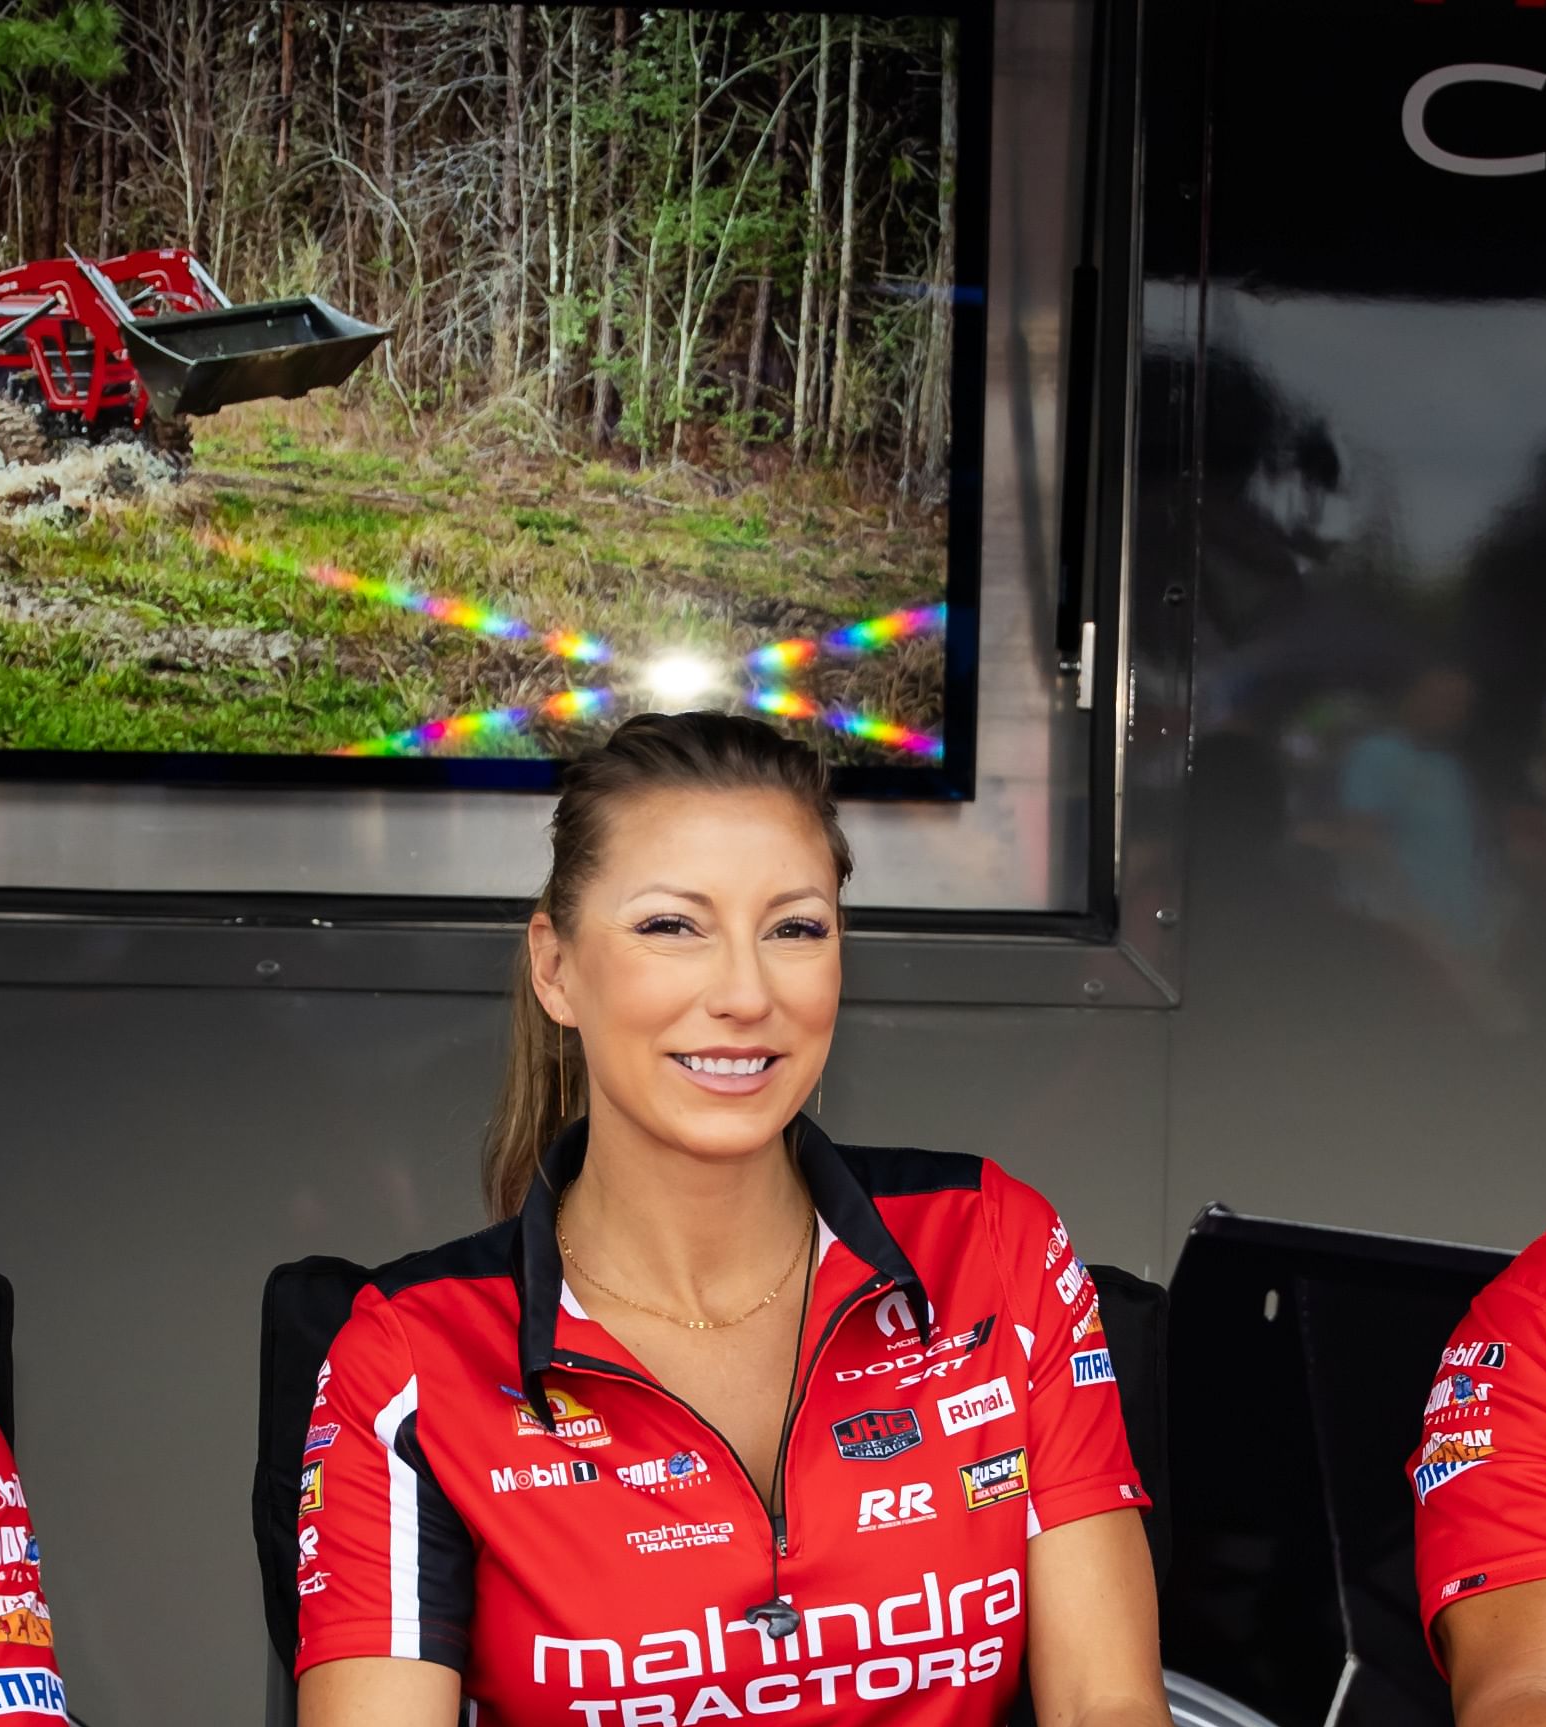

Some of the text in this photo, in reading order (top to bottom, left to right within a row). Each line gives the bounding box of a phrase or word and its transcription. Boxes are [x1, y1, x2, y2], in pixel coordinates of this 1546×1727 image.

[887, 1326, 942, 1351] MOPR
[835, 1329, 978, 1382] DODGE
[895, 1354, 972, 1390] SRT
[840, 1412, 914, 1444] JHG
[490, 1462, 568, 1494] Mobil
[617, 1450, 709, 1487] CODE 3
[972, 1456, 1017, 1489] RUSH
[858, 1482, 937, 1527] RR
[626, 1522, 734, 1545] mahindra
[637, 1534, 730, 1554] TRACTORS
[534, 1567, 1021, 1689] mahindra
